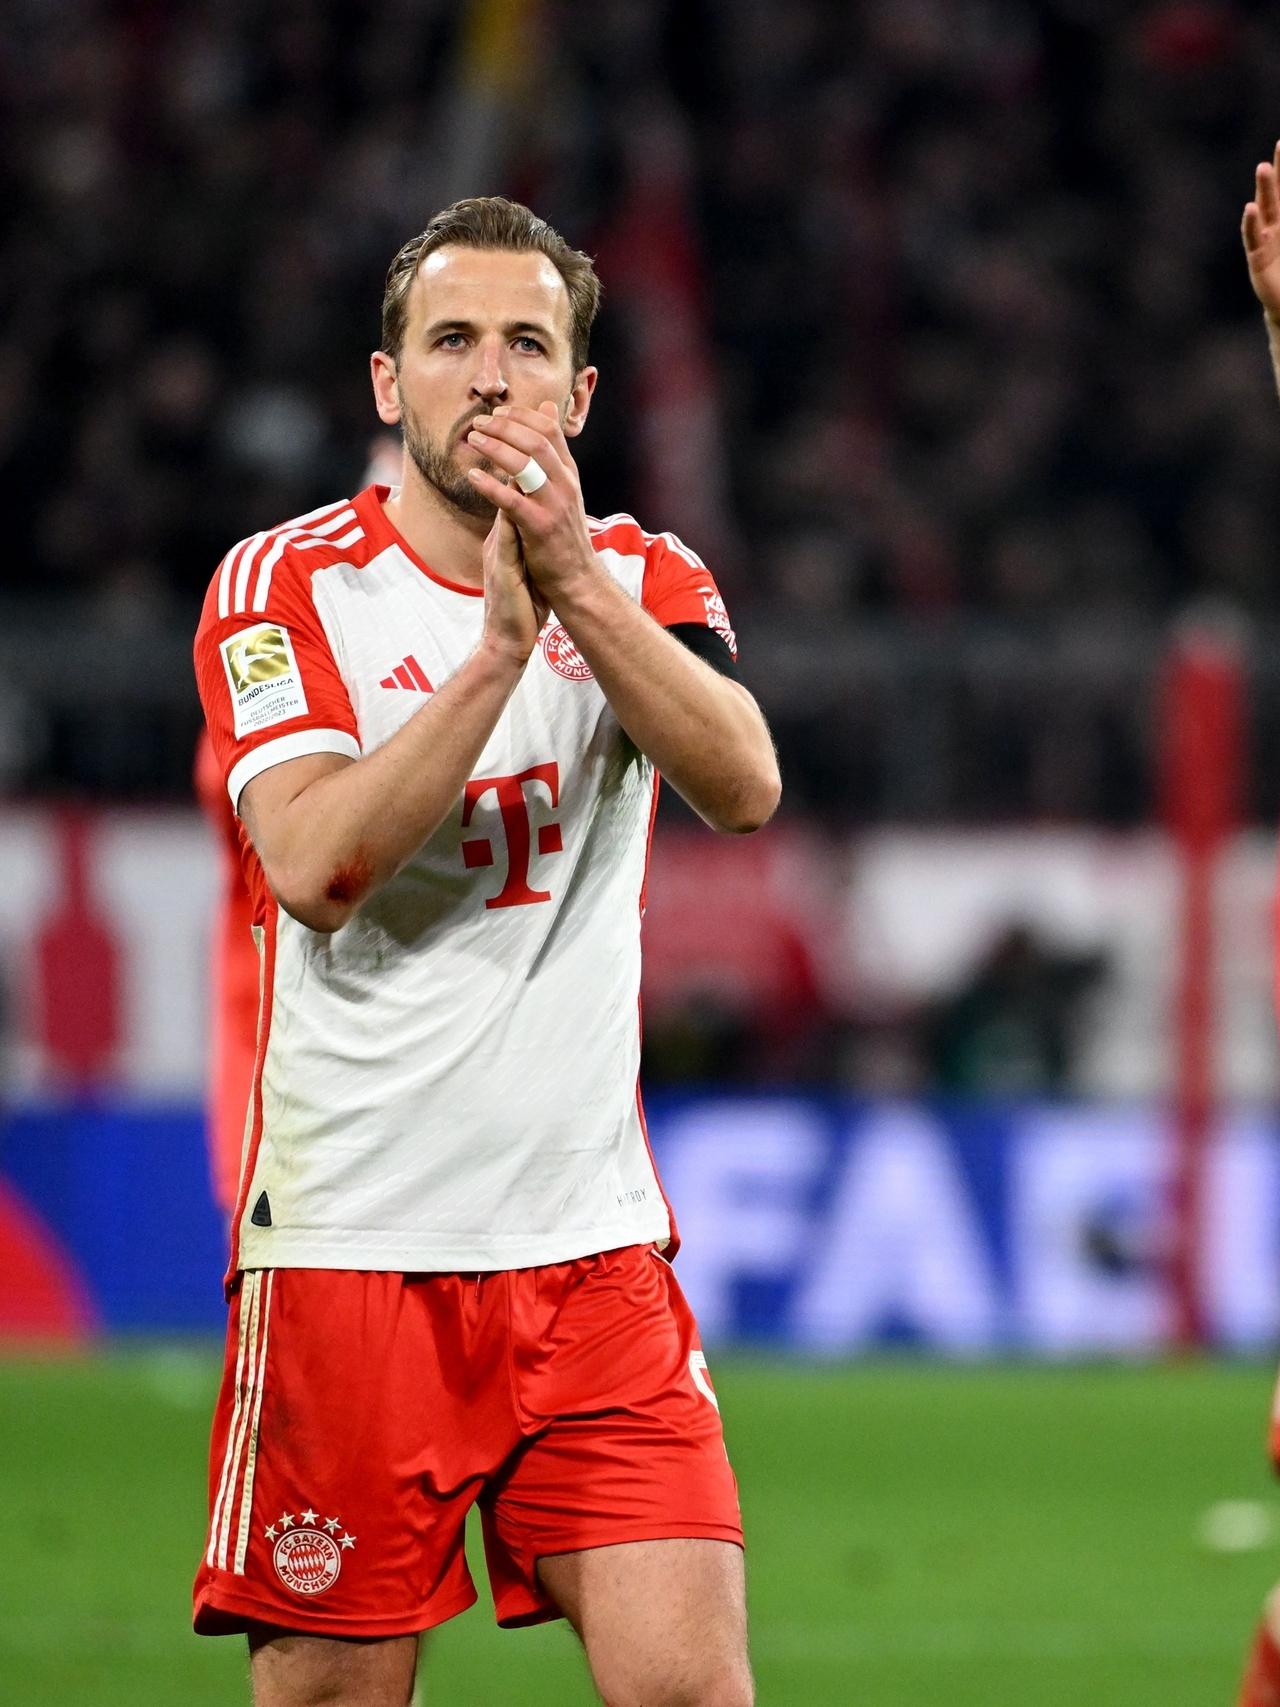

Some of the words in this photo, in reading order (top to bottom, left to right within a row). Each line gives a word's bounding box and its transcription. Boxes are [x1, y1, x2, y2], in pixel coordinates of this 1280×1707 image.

[238, 677, 294, 706] BUNDESLIGA
[461, 761, 563, 909] T
[280, 1541, 292, 1556] FC
[293, 1533, 335, 1560] BAYERN
